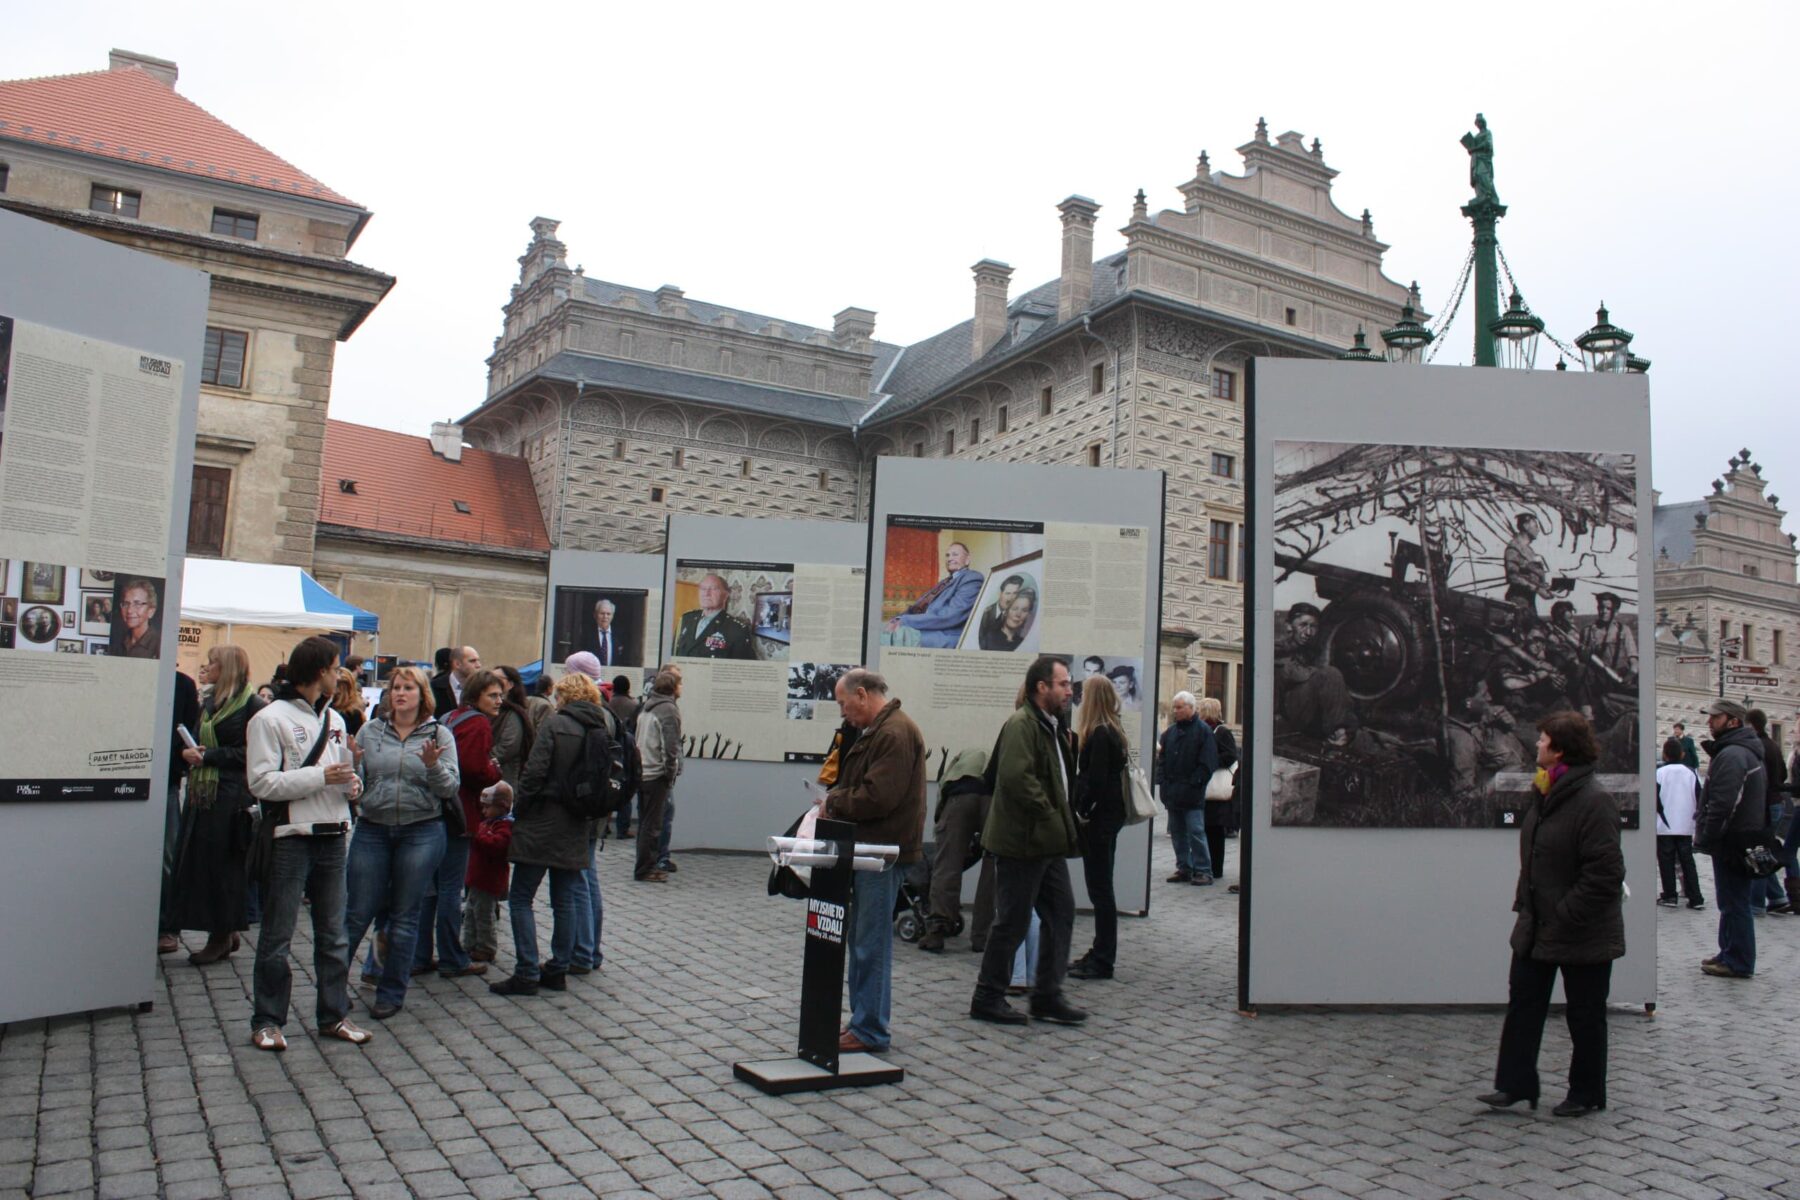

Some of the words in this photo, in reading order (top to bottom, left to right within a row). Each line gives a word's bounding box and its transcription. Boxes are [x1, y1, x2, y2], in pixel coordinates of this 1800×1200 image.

[809, 898, 821, 913] MY
[819, 901, 836, 918] JSME
[835, 905, 844, 920] TO
